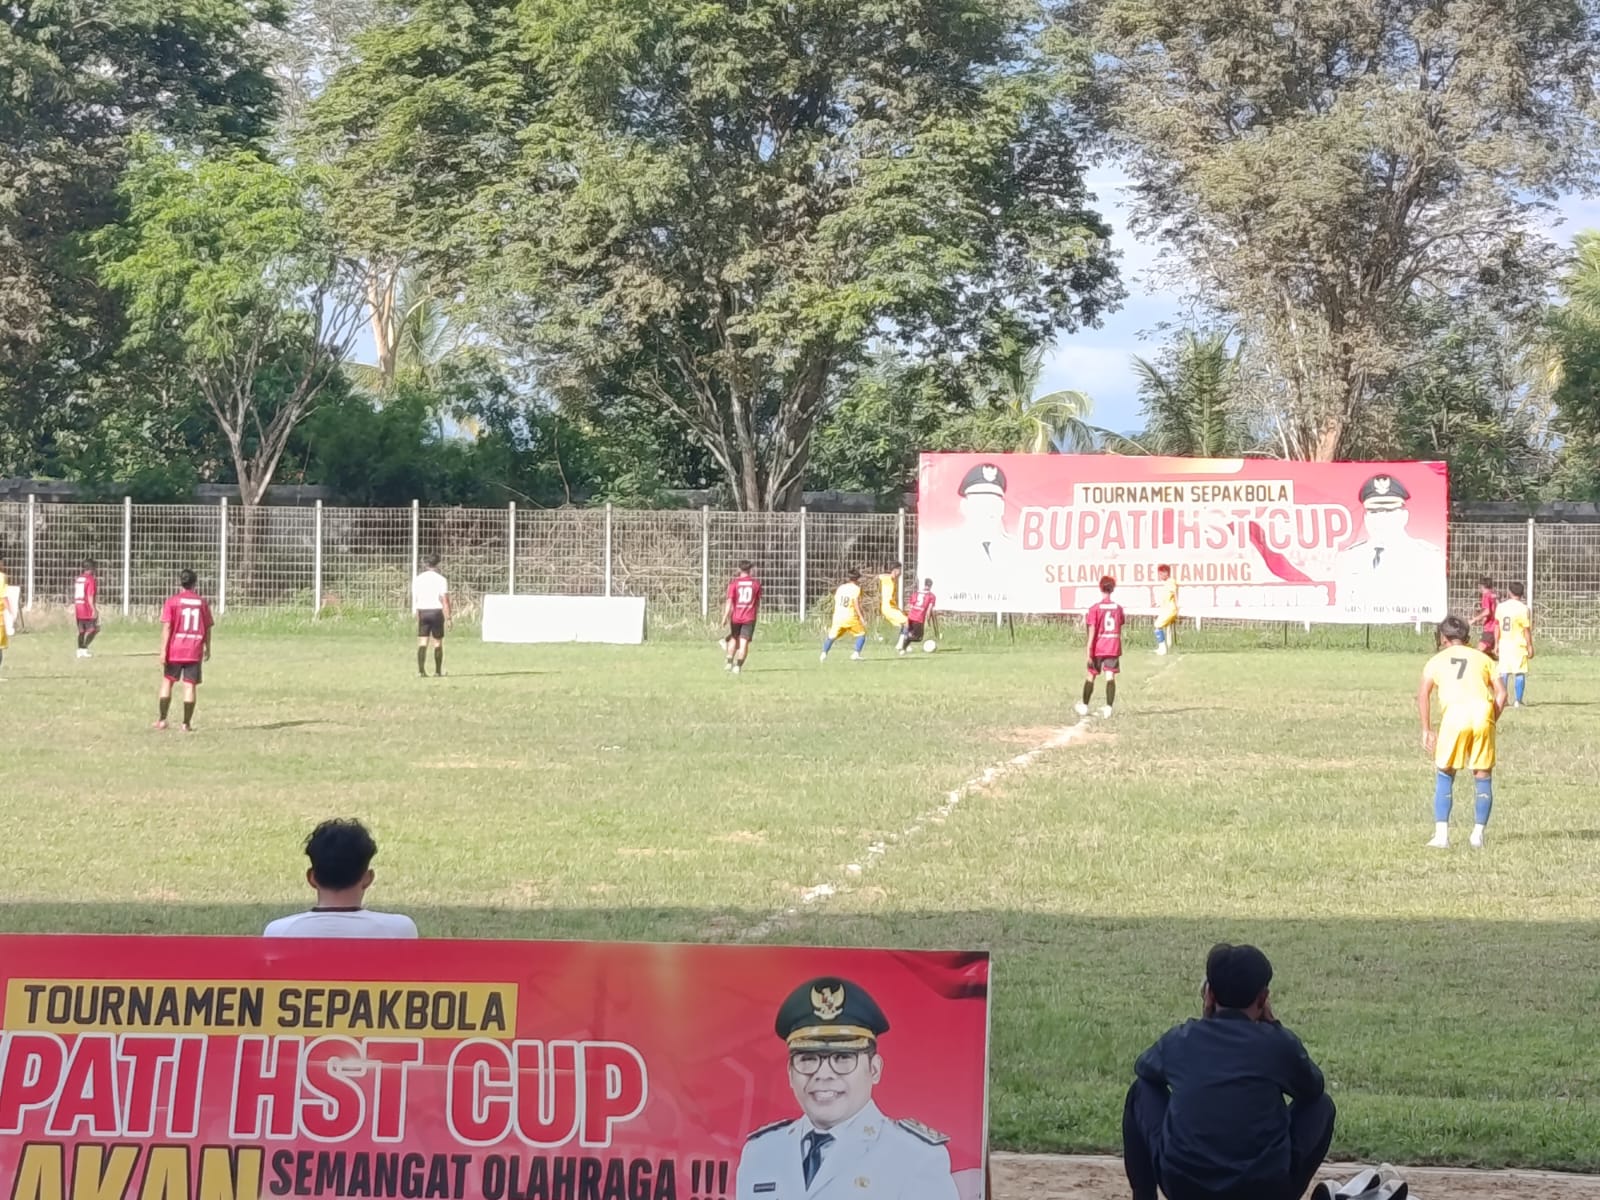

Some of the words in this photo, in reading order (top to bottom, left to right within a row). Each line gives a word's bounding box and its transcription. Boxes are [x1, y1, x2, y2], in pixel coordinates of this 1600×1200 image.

[1082, 486, 1184, 503] TOURNAMEN
[1191, 485, 1288, 503] SEPAKBOLA
[1023, 510, 1159, 550] BUPATI
[1269, 508, 1348, 549] CUP
[1045, 564, 1127, 583] SELAMAT
[1134, 563, 1252, 582] BETANDING
[738, 586, 752, 603] 10
[182, 607, 200, 631] 11
[1104, 610, 1115, 632] 6
[1502, 616, 1511, 632] 8
[1450, 657, 1468, 680] 7
[24, 985, 264, 1027] TOURNAMEN
[277, 988, 506, 1031] SEPAKBOLA
[0, 1030, 208, 1138] PATI
[229, 1034, 424, 1142] HST
[447, 1037, 649, 1148] CUP
[269, 1149, 473, 1199] SEMANGAT
[481, 1153, 678, 1200] OLAHRAGA
